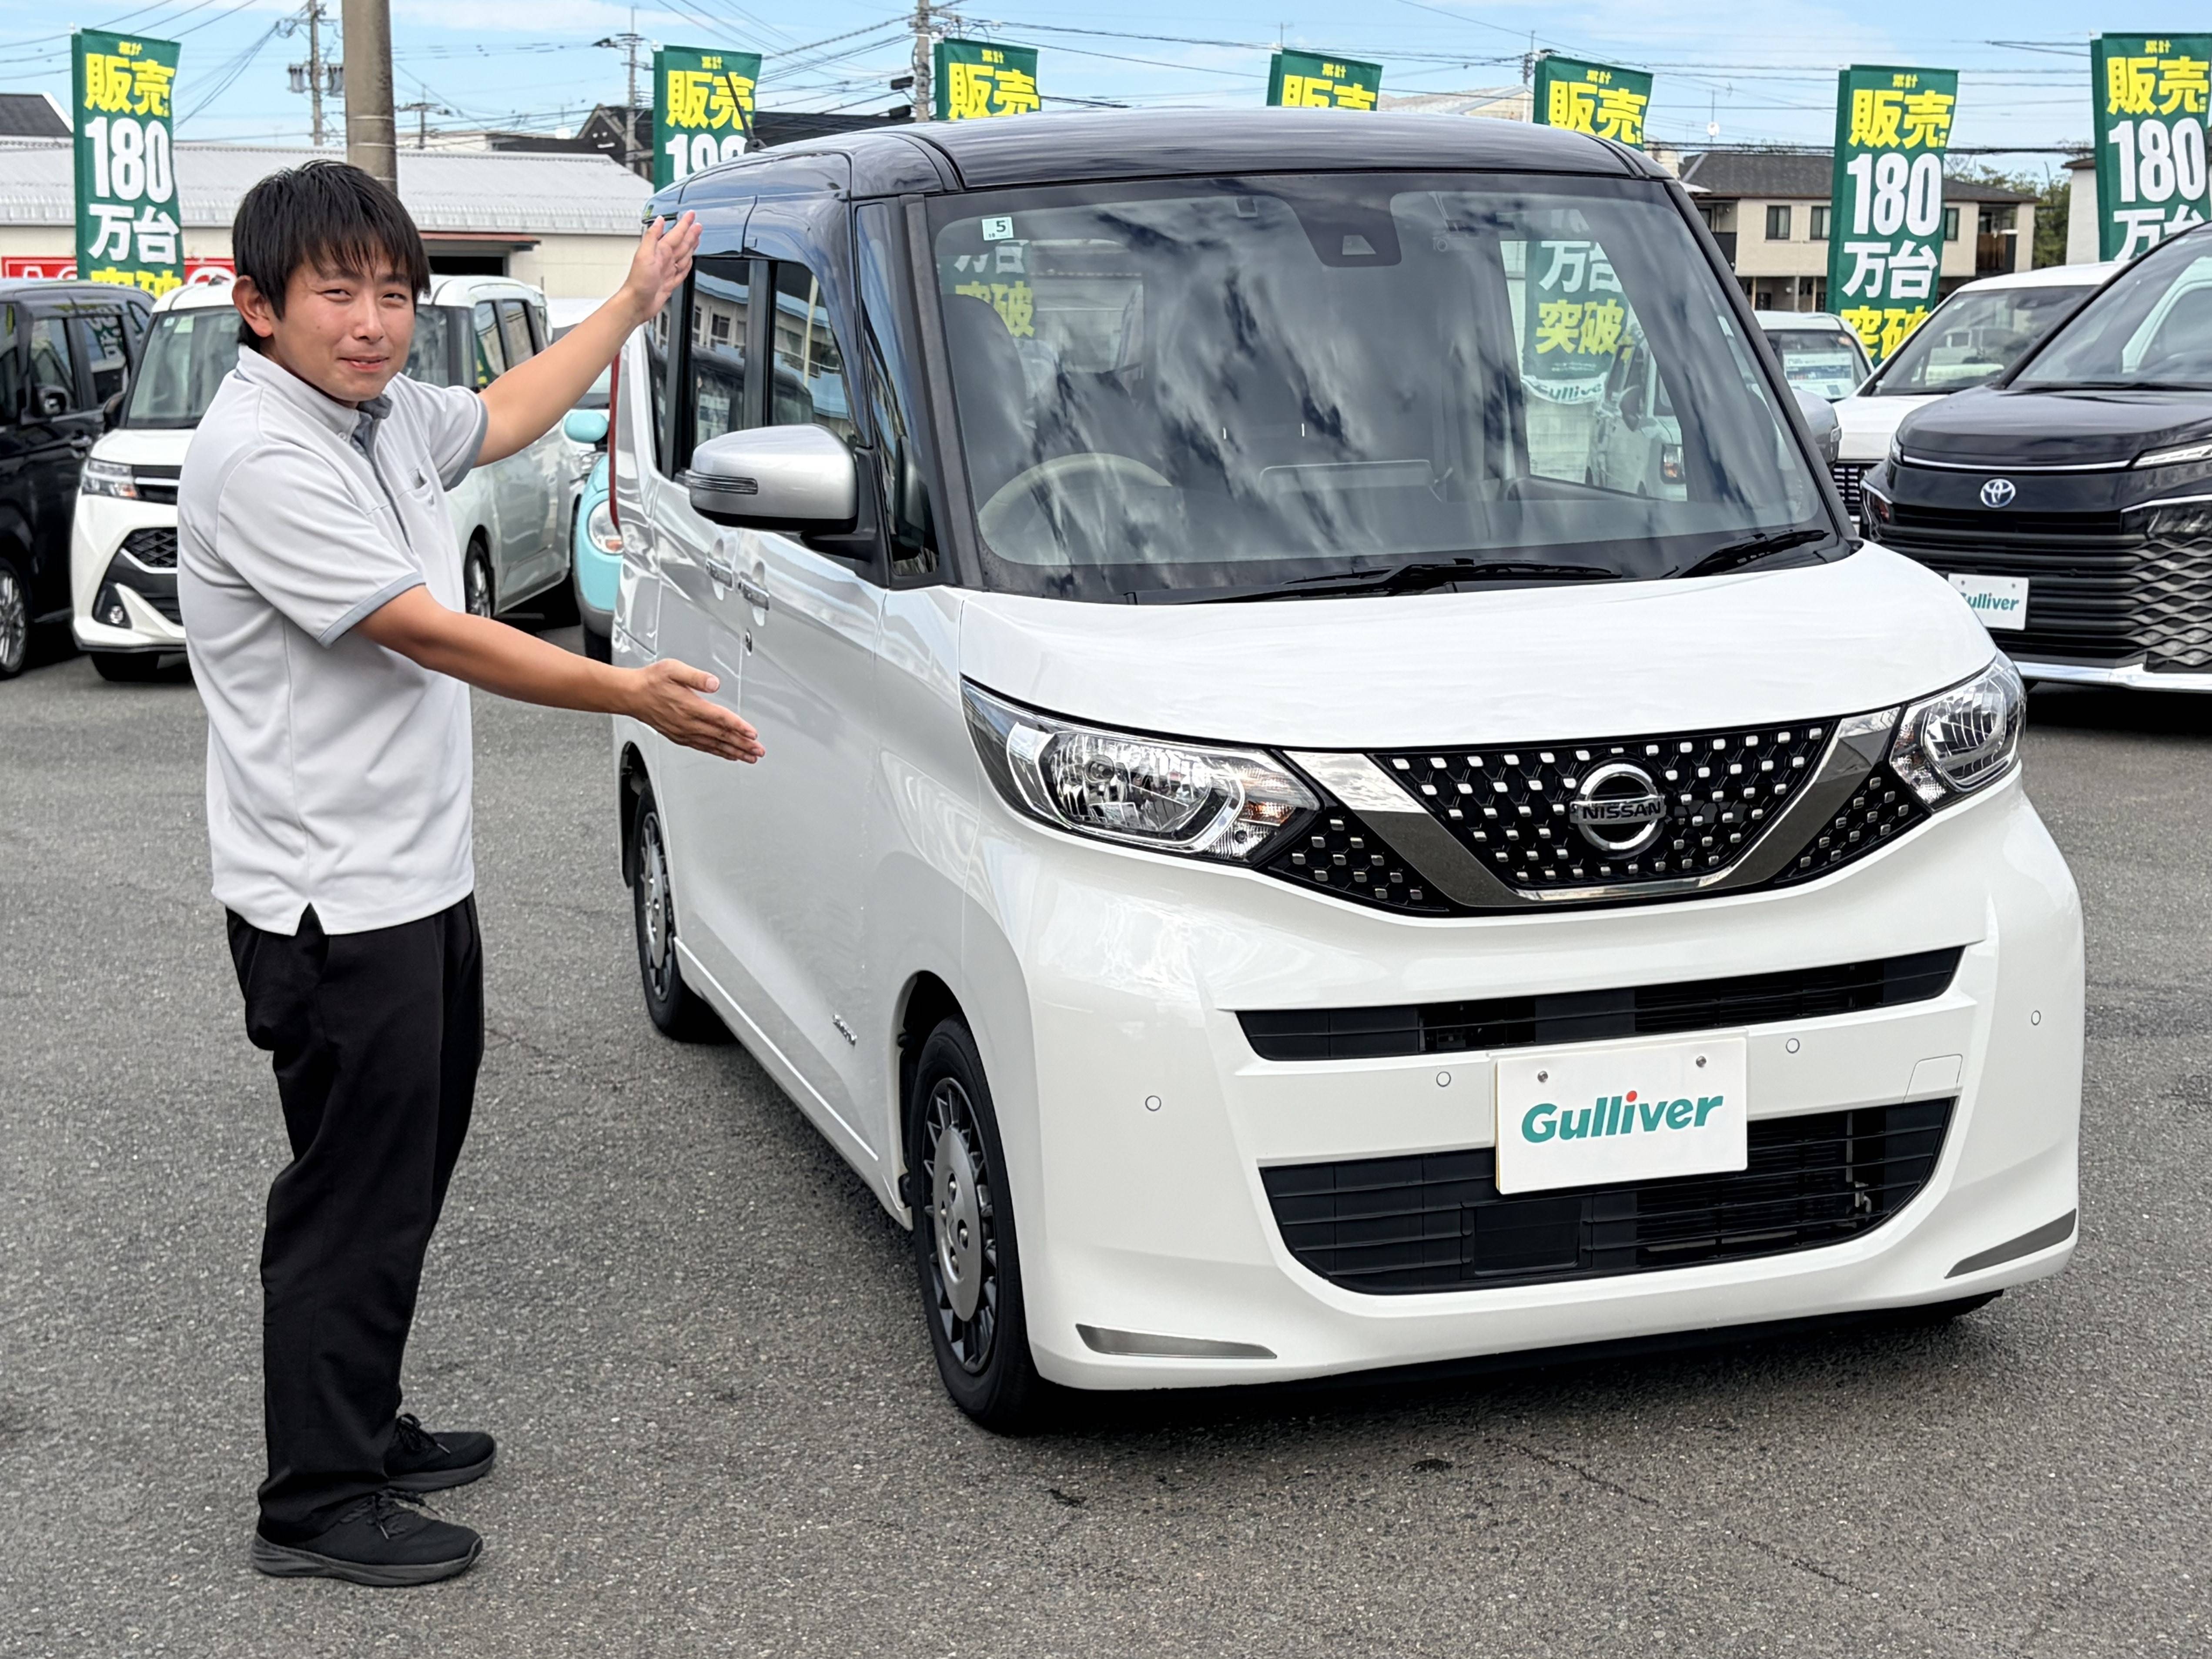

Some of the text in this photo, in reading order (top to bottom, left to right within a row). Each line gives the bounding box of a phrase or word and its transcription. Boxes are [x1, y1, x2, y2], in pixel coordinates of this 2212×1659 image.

[84, 53, 175, 116] 販売
[665, 70, 754, 130] 販売
[947, 63, 1040, 121] 販売
[1548, 80, 1647, 144] 販売
[2107, 55, 2209, 115] 販売
[1848, 89, 1954, 149] 販売
[84, 116, 173, 203] 180
[2108, 117, 2206, 202] 180
[1847, 152, 1941, 236] 180
[87, 203, 180, 264] 万台
[996, 220, 1006, 233] 5
[1841, 240, 1938, 299] 万台
[1535, 298, 1624, 355] 突破
[1583, 801, 1661, 819] NISSAN
[1522, 1090, 1723, 1143] Gulliver
